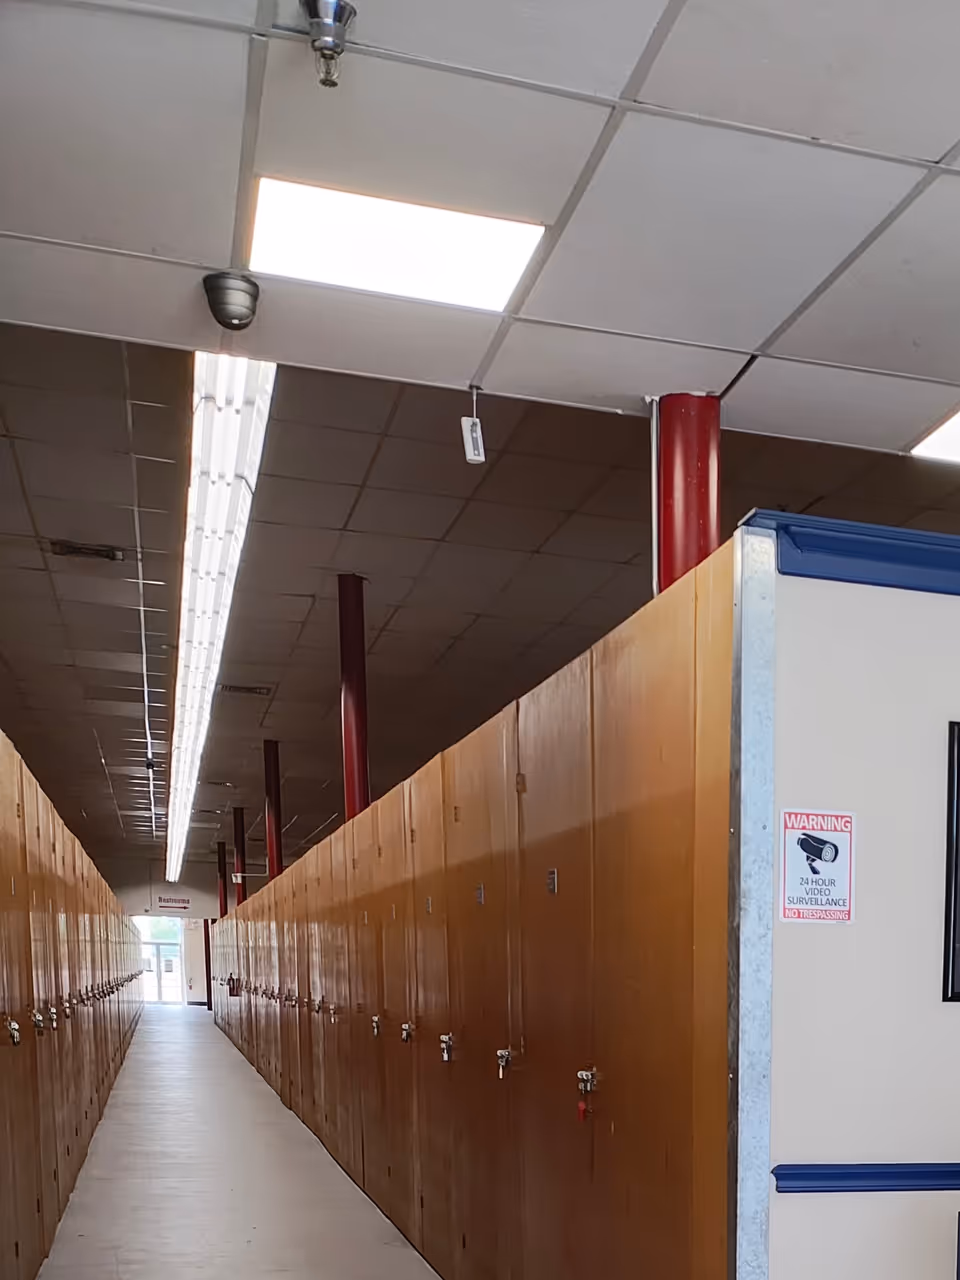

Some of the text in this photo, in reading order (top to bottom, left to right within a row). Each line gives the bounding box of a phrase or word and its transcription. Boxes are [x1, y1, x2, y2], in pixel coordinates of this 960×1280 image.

[785, 813, 852, 831] WARNING
[799, 877, 836, 887] 24 HOUR
[804, 887, 831, 896] VIDEO
[158, 896, 190, 904] Restrooms
[787, 896, 848, 907] SURVEILLANCE
[785, 908, 849, 920] NO TRESPASSING
